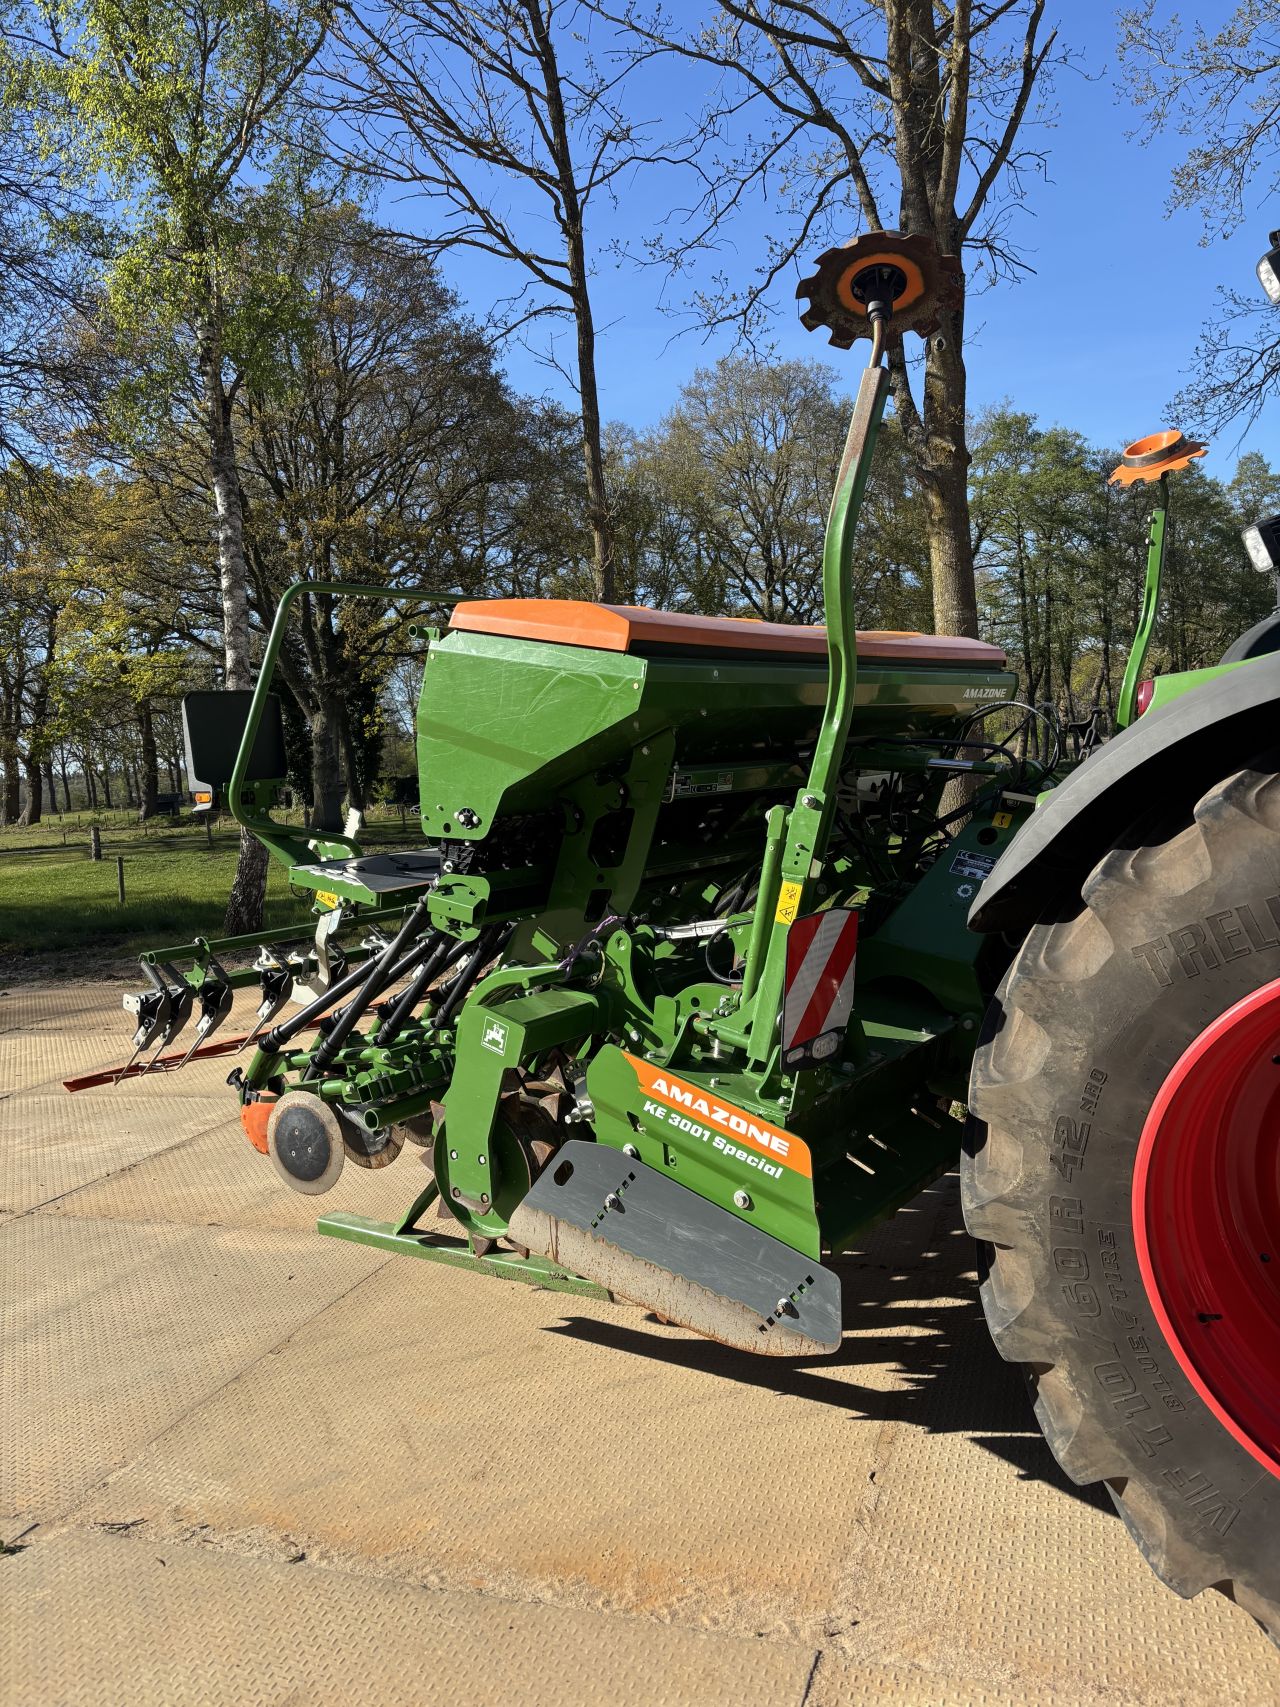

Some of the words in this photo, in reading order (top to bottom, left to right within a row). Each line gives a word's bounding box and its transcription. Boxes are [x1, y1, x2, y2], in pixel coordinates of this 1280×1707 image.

[962, 687, 1007, 699] AMAZONE
[643, 1100, 668, 1120] KE
[668, 1113, 711, 1142] 3001
[712, 1135, 784, 1179] Special
[651, 1078, 790, 1157] AMAZONE
[1049, 1114, 1092, 1184] 42
[1097, 1229, 1128, 1302] TIRE
[1128, 1334, 1186, 1413] BLUE
